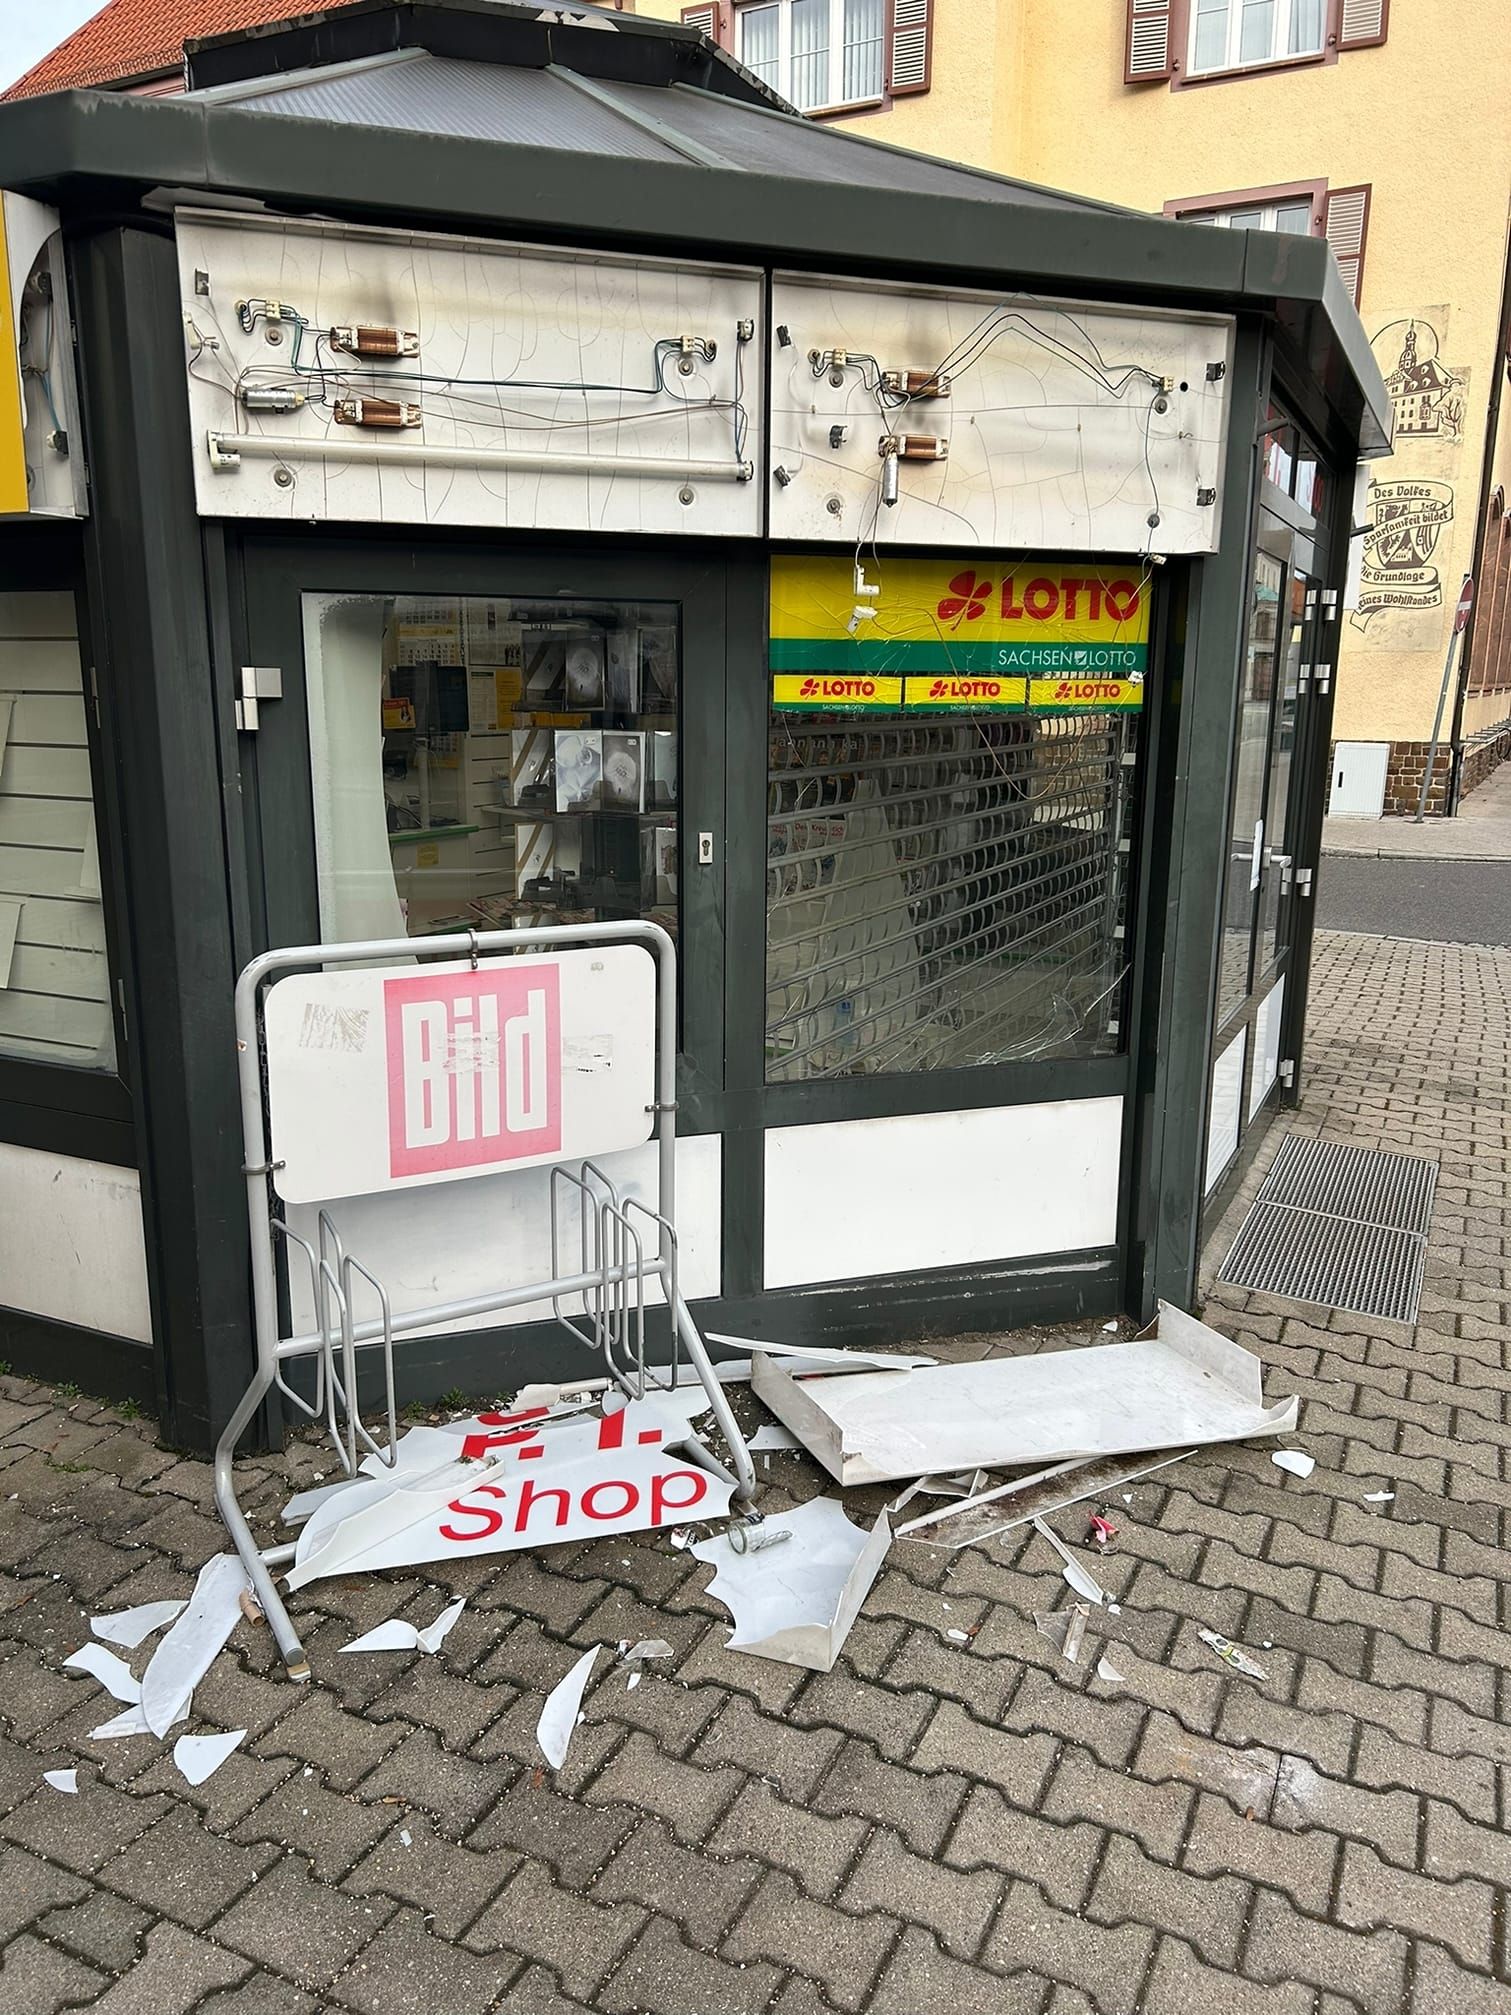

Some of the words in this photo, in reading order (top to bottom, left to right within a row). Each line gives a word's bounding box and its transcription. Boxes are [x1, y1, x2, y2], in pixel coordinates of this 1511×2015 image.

[1374, 488, 1393, 499] Des
[1422, 509, 1448, 523] bildet
[1373, 571, 1425, 583] Grundlage
[1001, 577, 1140, 622] LOTTO
[998, 649, 1073, 667] SACHSEN
[1089, 650, 1137, 667] LOTTO
[823, 680, 875, 696] LOTTO
[951, 682, 1001, 697] LOTTO
[1075, 684, 1121, 698] LOTTO
[439, 1470, 708, 1542] Shop
